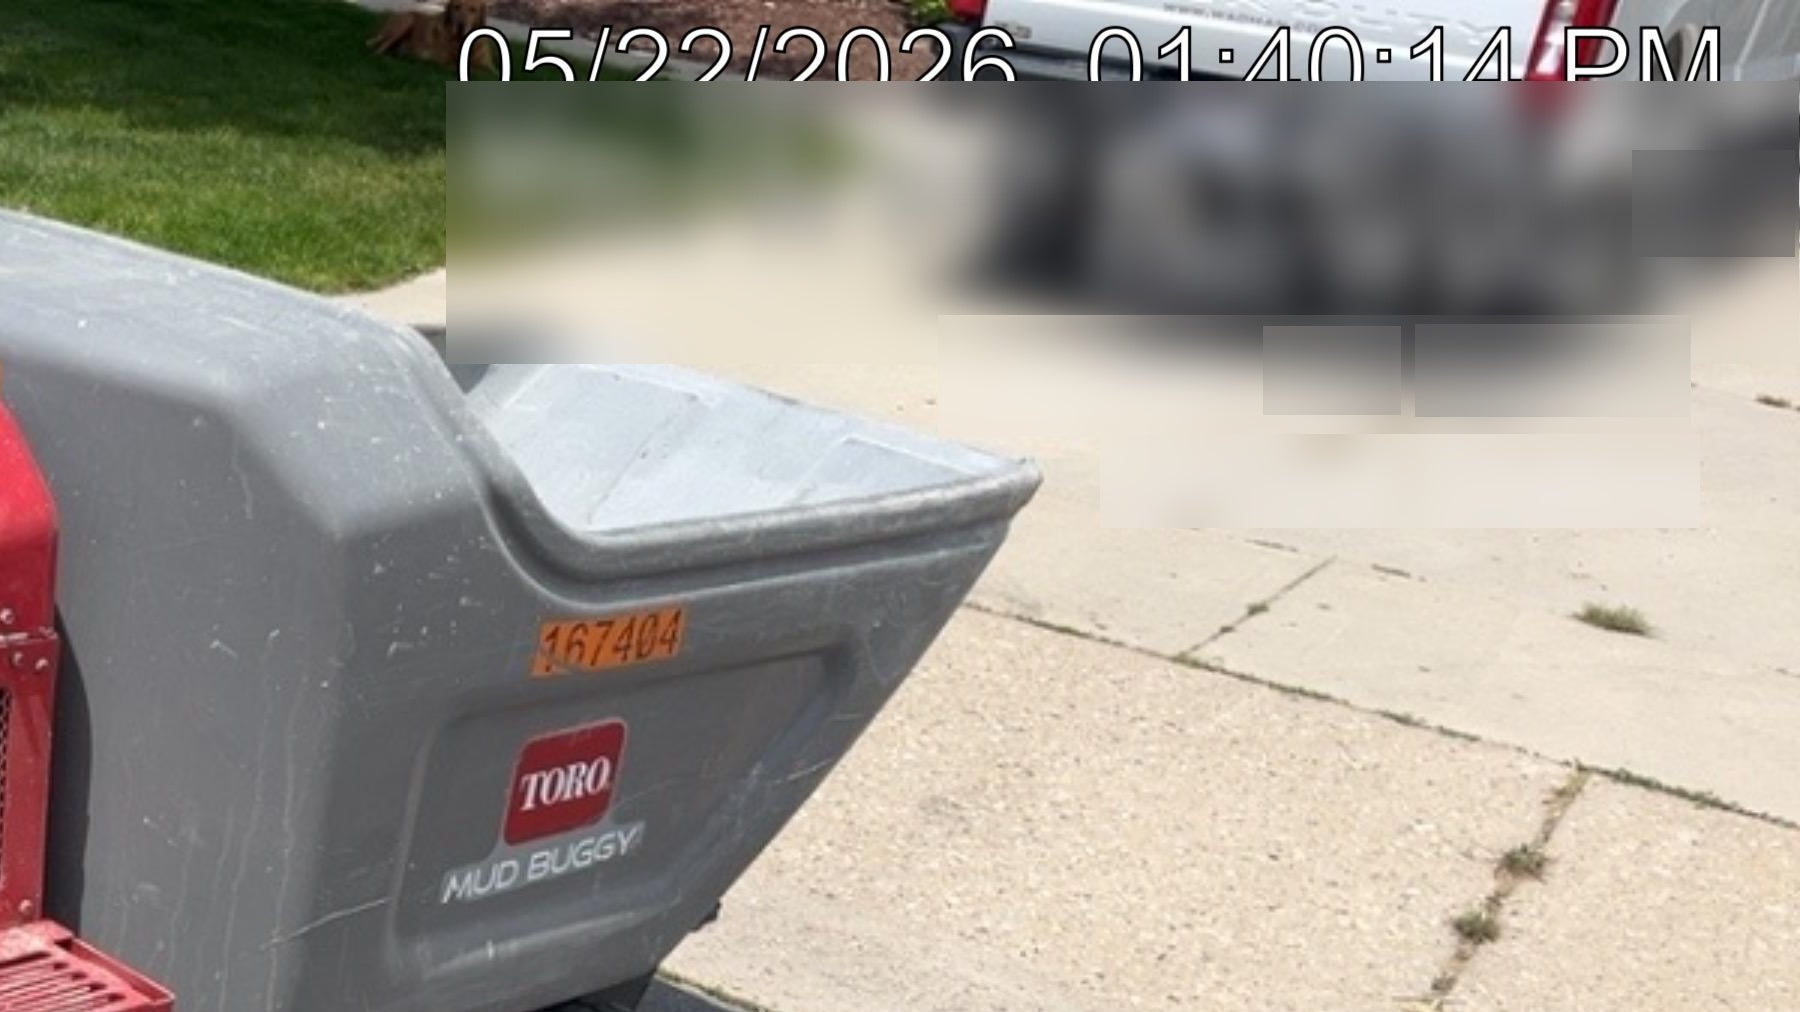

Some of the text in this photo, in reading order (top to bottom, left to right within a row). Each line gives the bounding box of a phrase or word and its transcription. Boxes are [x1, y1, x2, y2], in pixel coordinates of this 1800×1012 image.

[543, 607, 682, 672] 167404
[519, 756, 612, 812] TORO
[440, 826, 638, 904] MUD BUGGY
